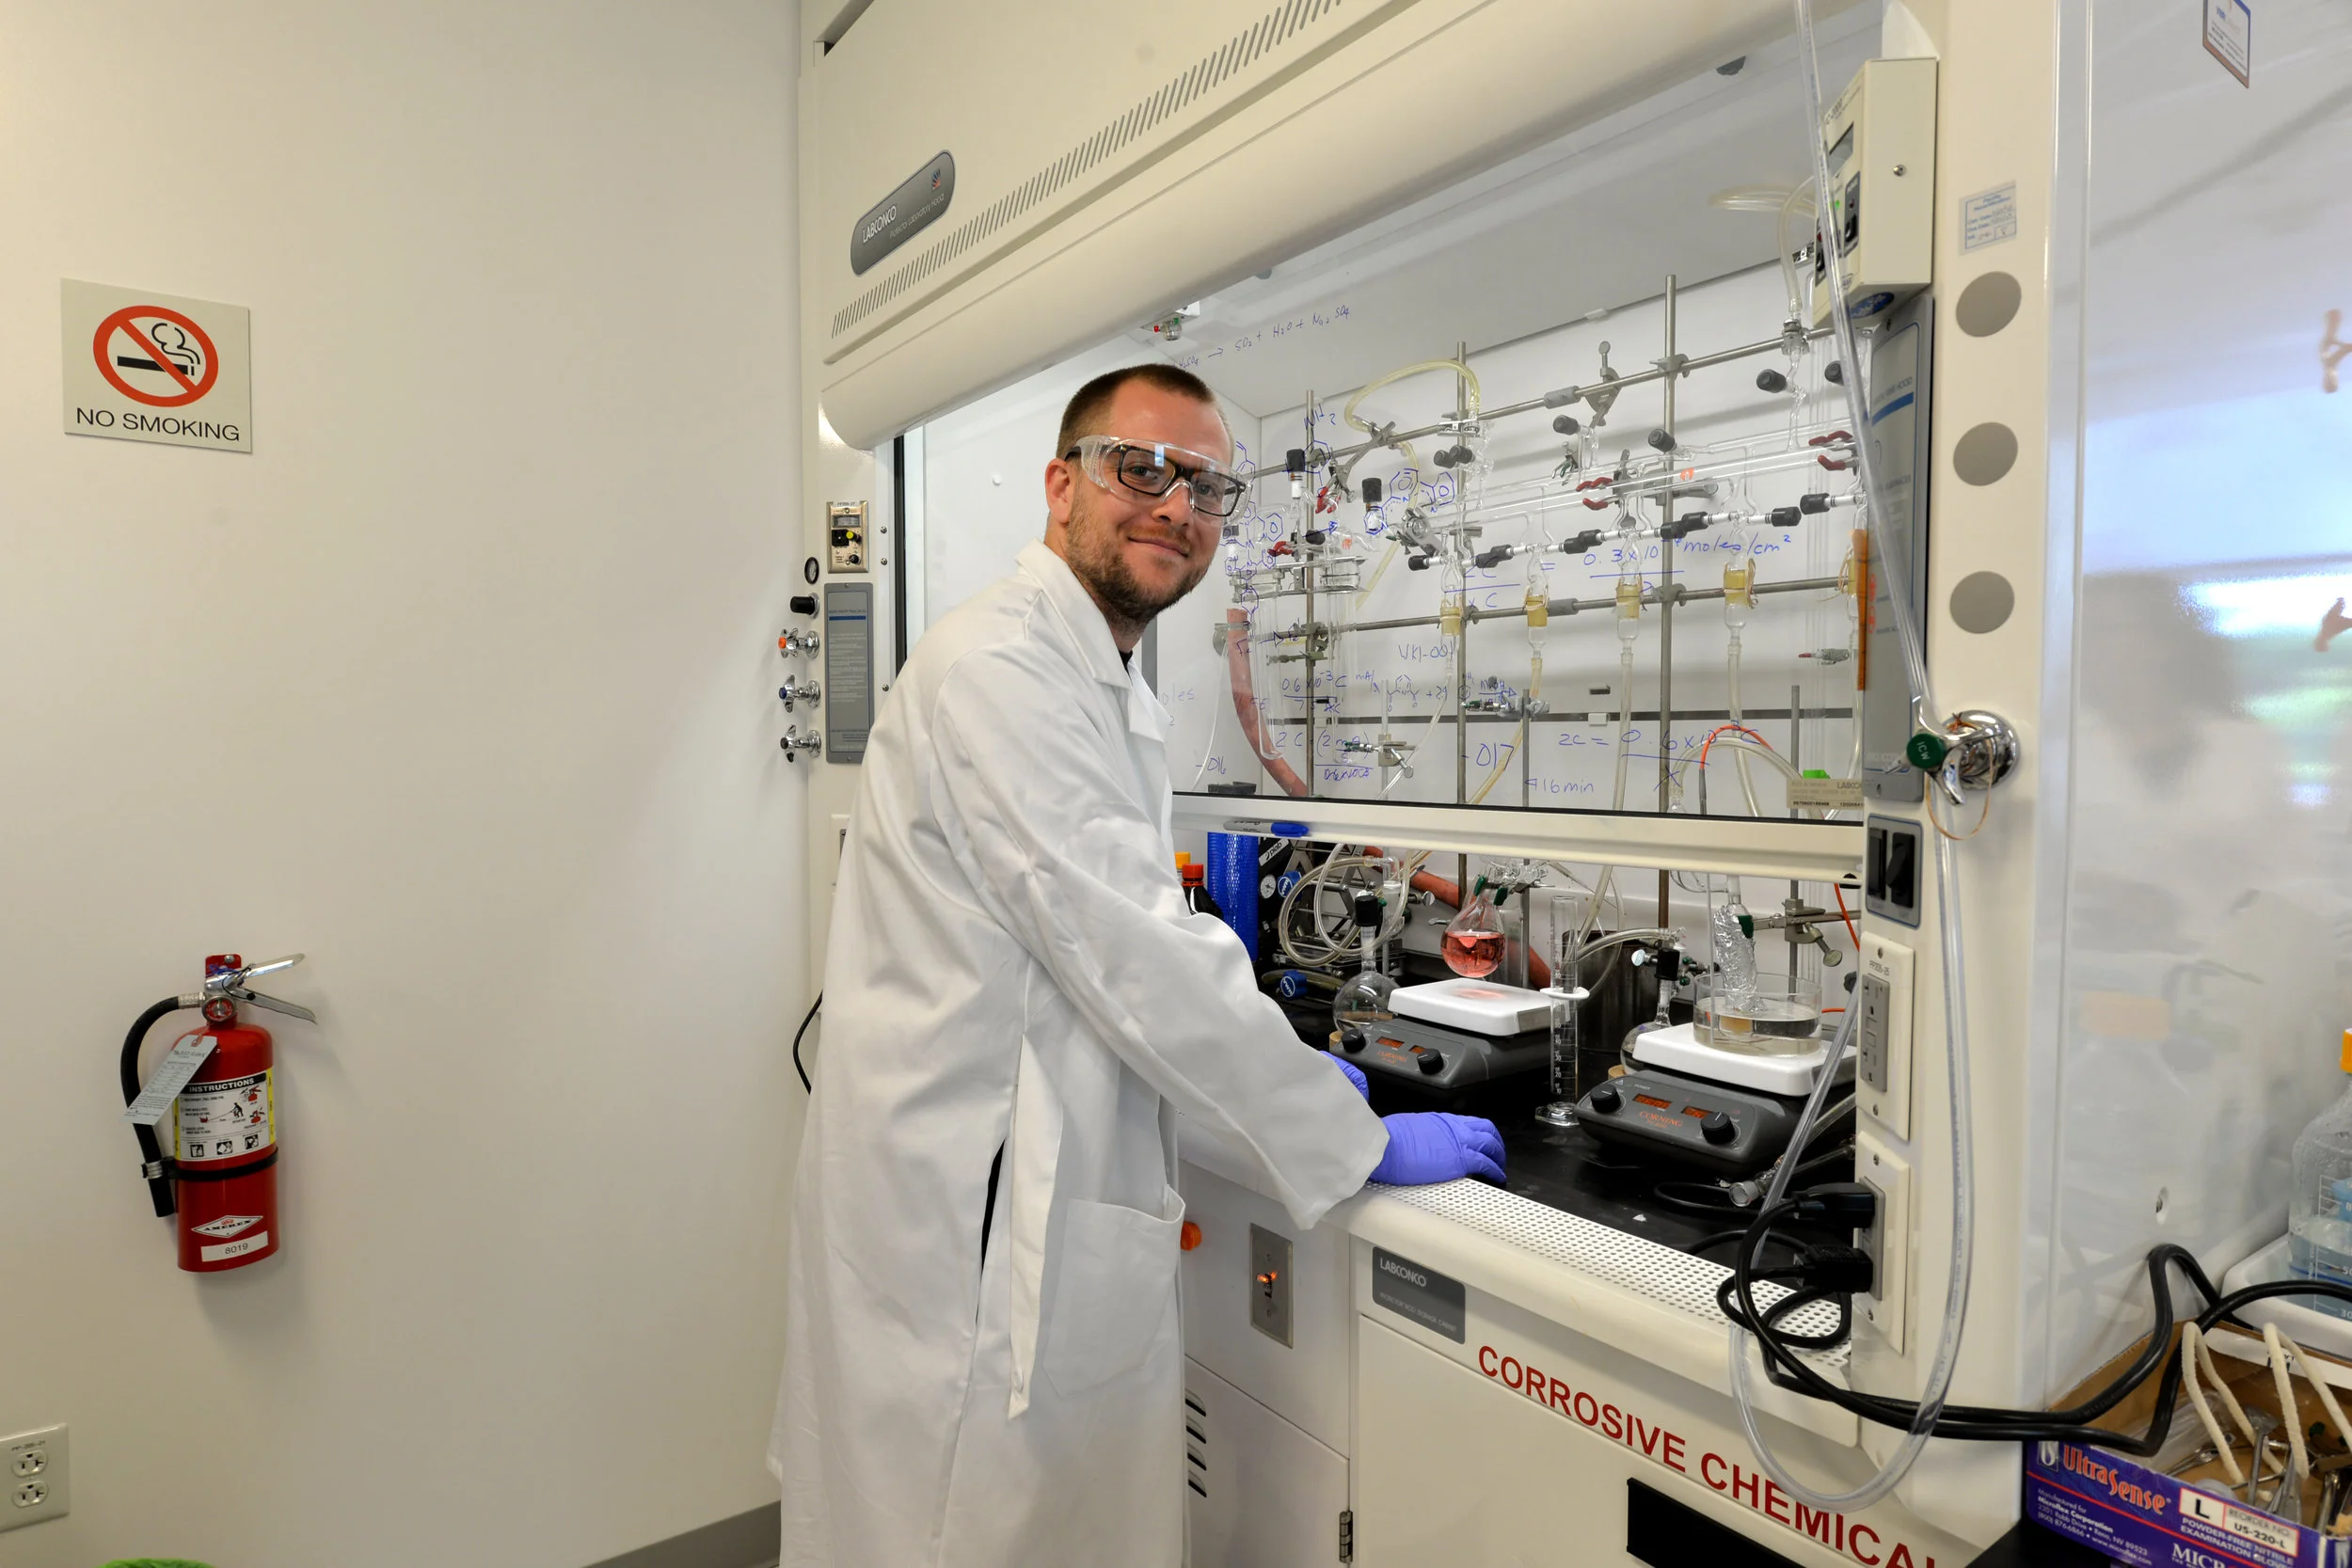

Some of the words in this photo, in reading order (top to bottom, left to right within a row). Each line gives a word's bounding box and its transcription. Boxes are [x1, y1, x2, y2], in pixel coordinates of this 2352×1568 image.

[862, 205, 897, 244] LABCONCO
[76, 407, 115, 428] NO
[122, 413, 240, 441] SMOKING
[188, 1077, 255, 1092] INSTRUCTIONS
[1639, 1112, 1683, 1128] CORNING
[225, 1243, 248, 1255] 8019
[1379, 1257, 1427, 1288] LABCONCO
[1479, 1345, 1687, 1473] CORROSIVE
[2063, 1445, 2167, 1516] UltraSense
[2038, 1497, 2070, 1514] Microflex
[2071, 1509, 2114, 1534] Corporation
[2195, 1498, 2210, 1519] L
[2229, 1507, 2269, 1530] REORDER
[2180, 1525, 2251, 1559] EXAMINATION
[2182, 1516, 2252, 1550] POWDER-FREE
[2253, 1545, 2295, 1566] NITRILE
[2233, 1522, 2287, 1549] US-220-L
